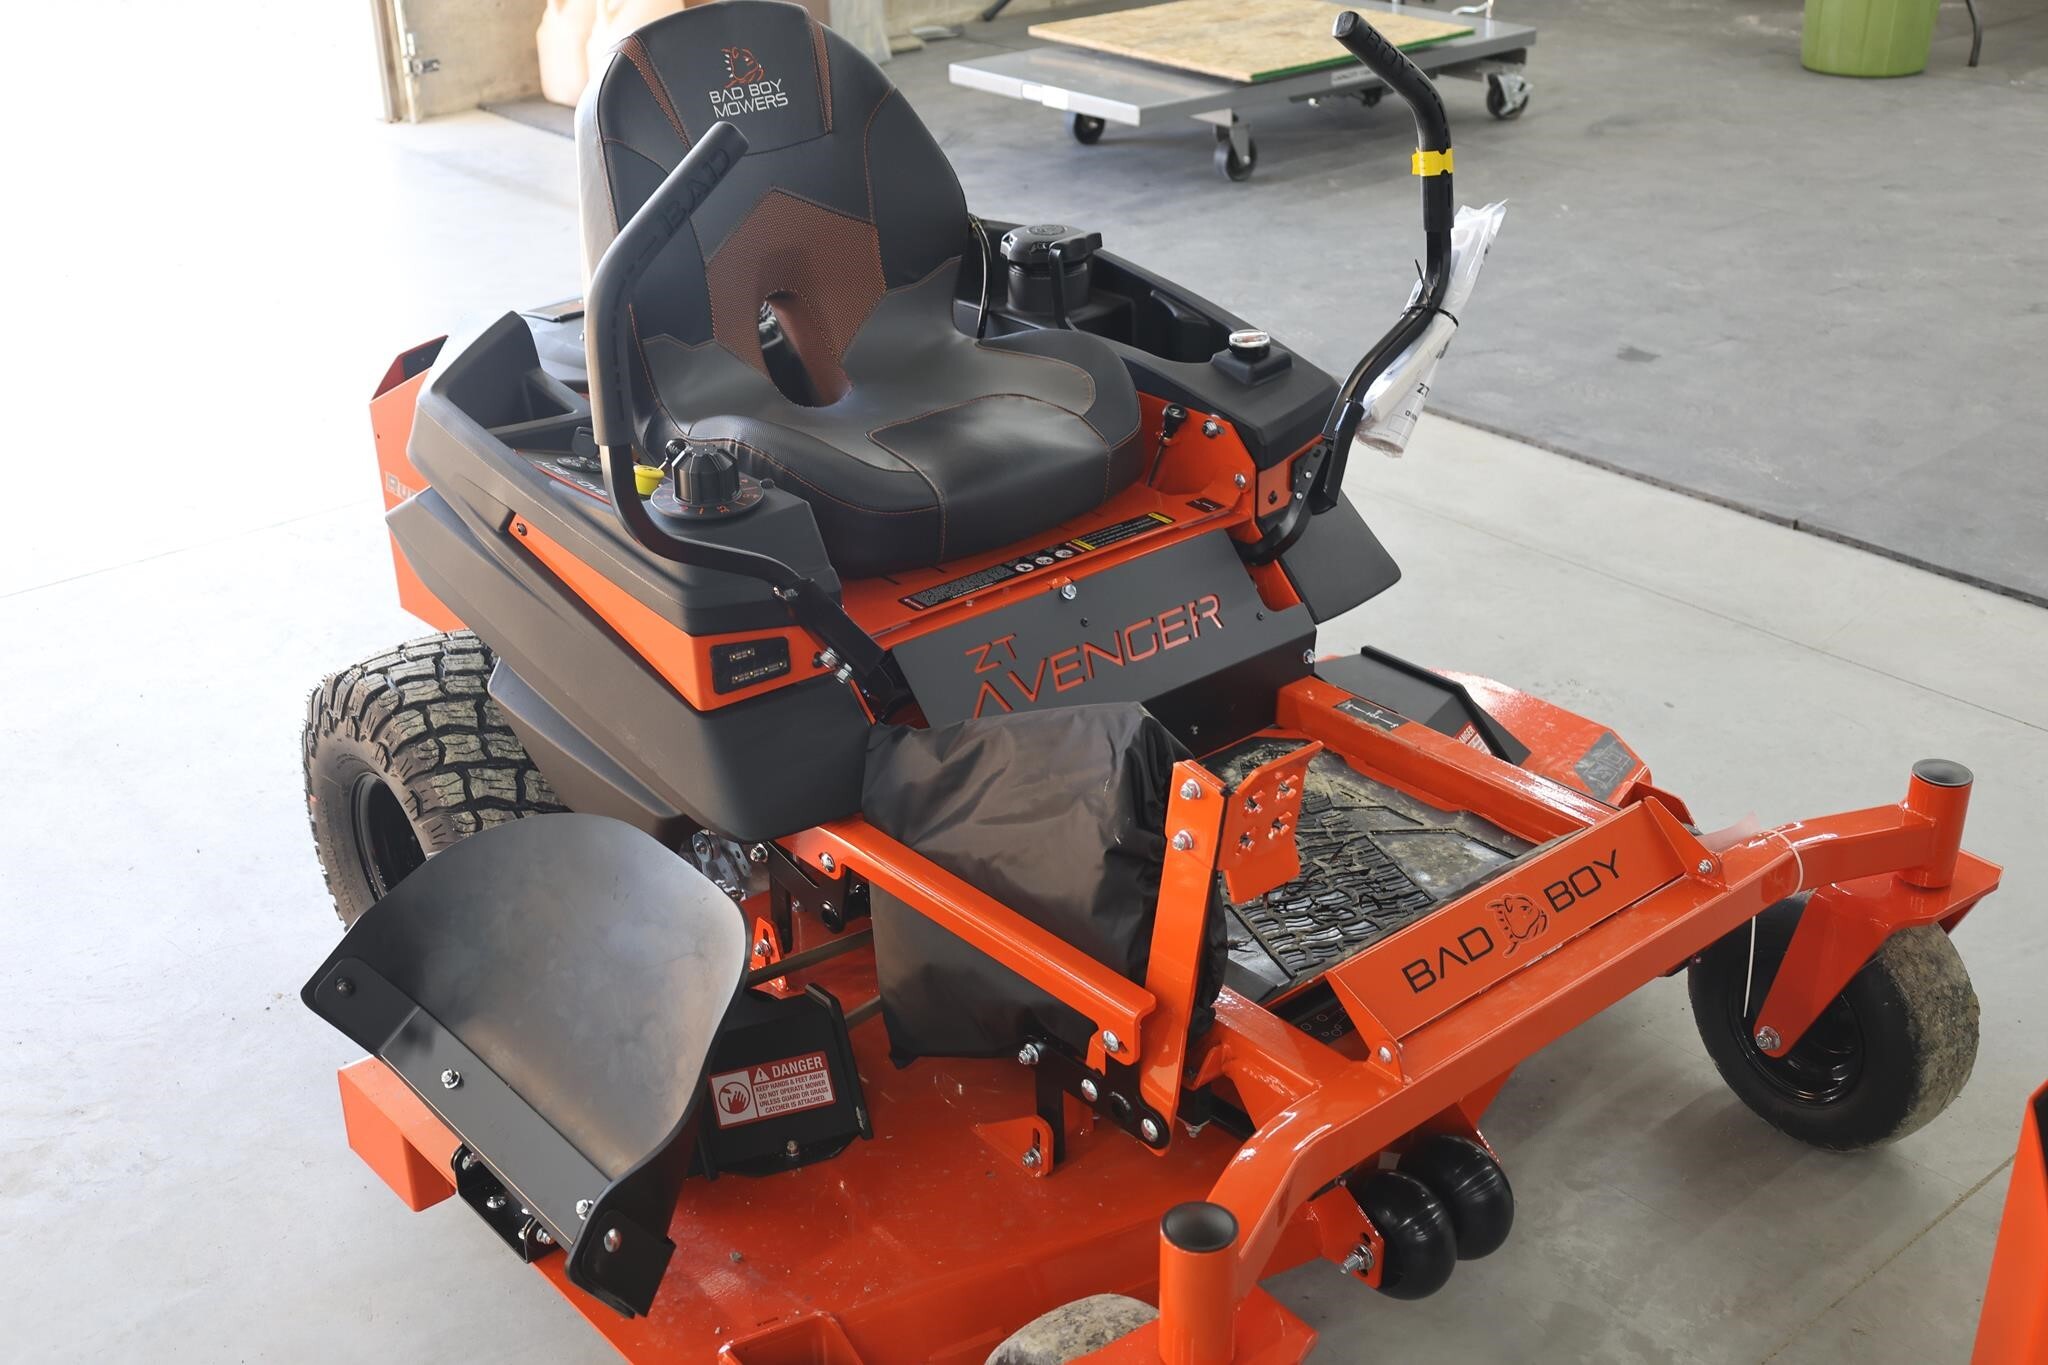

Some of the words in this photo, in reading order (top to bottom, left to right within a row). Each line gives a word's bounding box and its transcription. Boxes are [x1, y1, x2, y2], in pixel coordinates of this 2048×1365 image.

[709, 87, 745, 104] BAD
[748, 78, 782, 97] BOY
[713, 92, 789, 118] MOWERS
[964, 633, 1018, 674] ZT
[972, 593, 1225, 720] AVENGER
[1401, 926, 1495, 994] BAD
[1542, 848, 1620, 913] BOY
[771, 1056, 824, 1079] DANGER
[755, 1085, 770, 1093] KEEP
[770, 1079, 790, 1089] HANDS
[795, 1075, 808, 1084] FEET
[758, 1092, 767, 1100] DO
[767, 1090, 779, 1098] NOT
[780, 1085, 804, 1095] OPERATE
[805, 1080, 826, 1090] MOWER
[759, 1097, 781, 1107] UNLESS
[781, 1093, 801, 1103] GUARD
[801, 1090, 810, 1098] OR
[810, 1087, 829, 1096] GRASS
[765, 1103, 790, 1113] CATCHER
